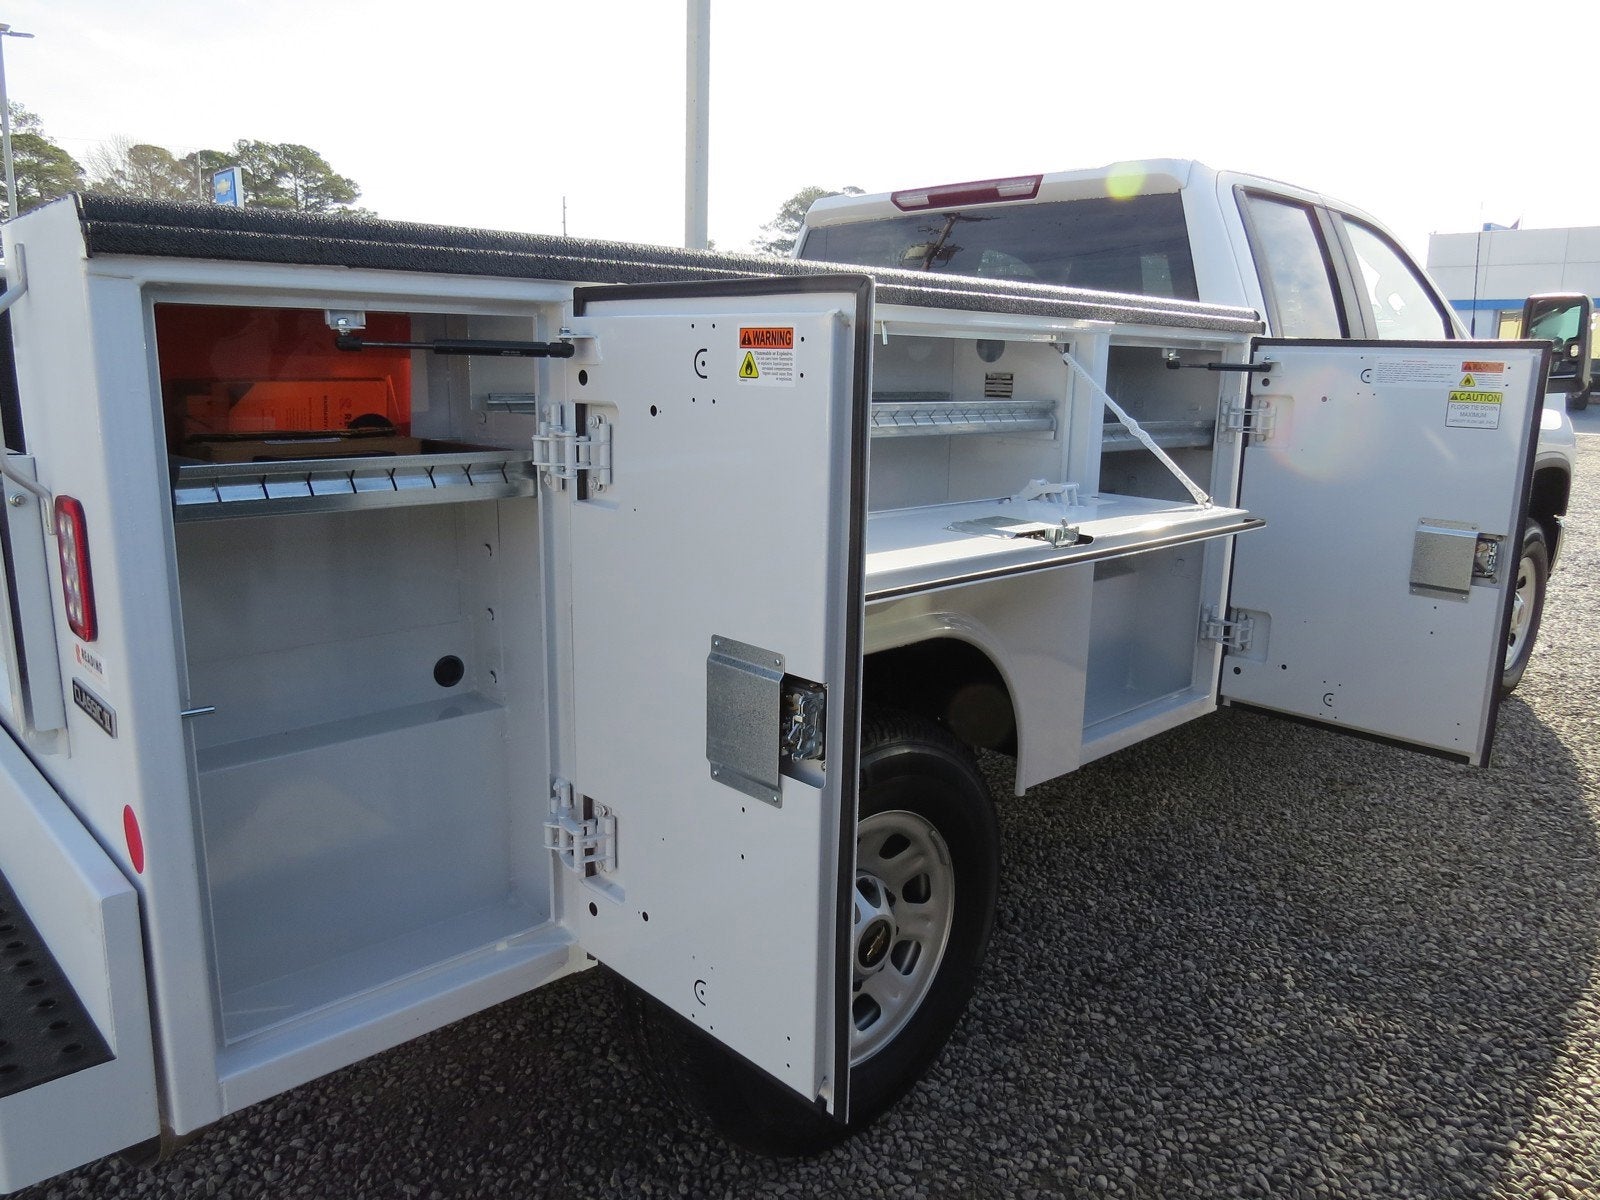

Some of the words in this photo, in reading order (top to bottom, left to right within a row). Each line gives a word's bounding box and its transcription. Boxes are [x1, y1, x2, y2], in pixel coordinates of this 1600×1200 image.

[752, 330, 792, 346] WARNING
[1460, 393, 1500, 402] CAUTION
[81, 647, 103, 675] READING
[74, 684, 105, 726] CLASSIC
